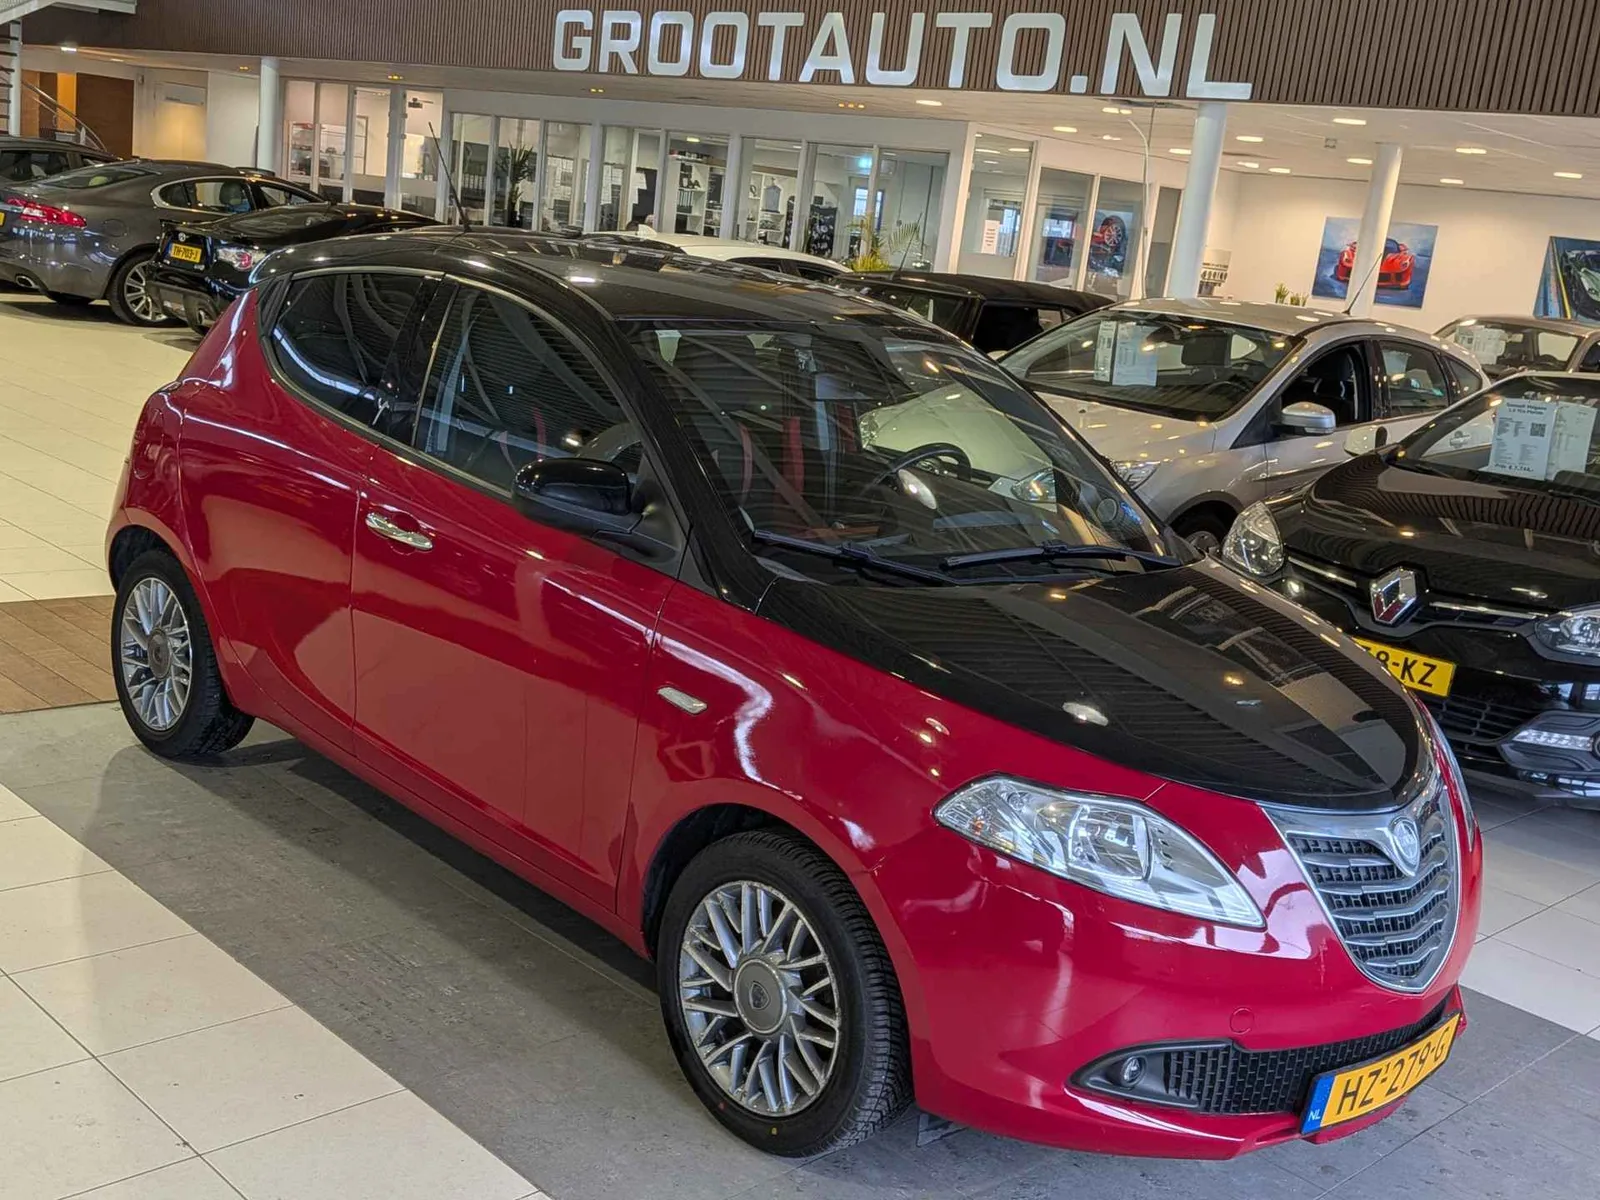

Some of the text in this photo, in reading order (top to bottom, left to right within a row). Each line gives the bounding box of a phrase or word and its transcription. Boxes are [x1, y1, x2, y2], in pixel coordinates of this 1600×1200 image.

[552, 8, 1252, 101] GROOTAUTO.NL
[1308, 1108, 1321, 1122] NL
[1336, 1027, 1450, 1115] HZ-279-G
